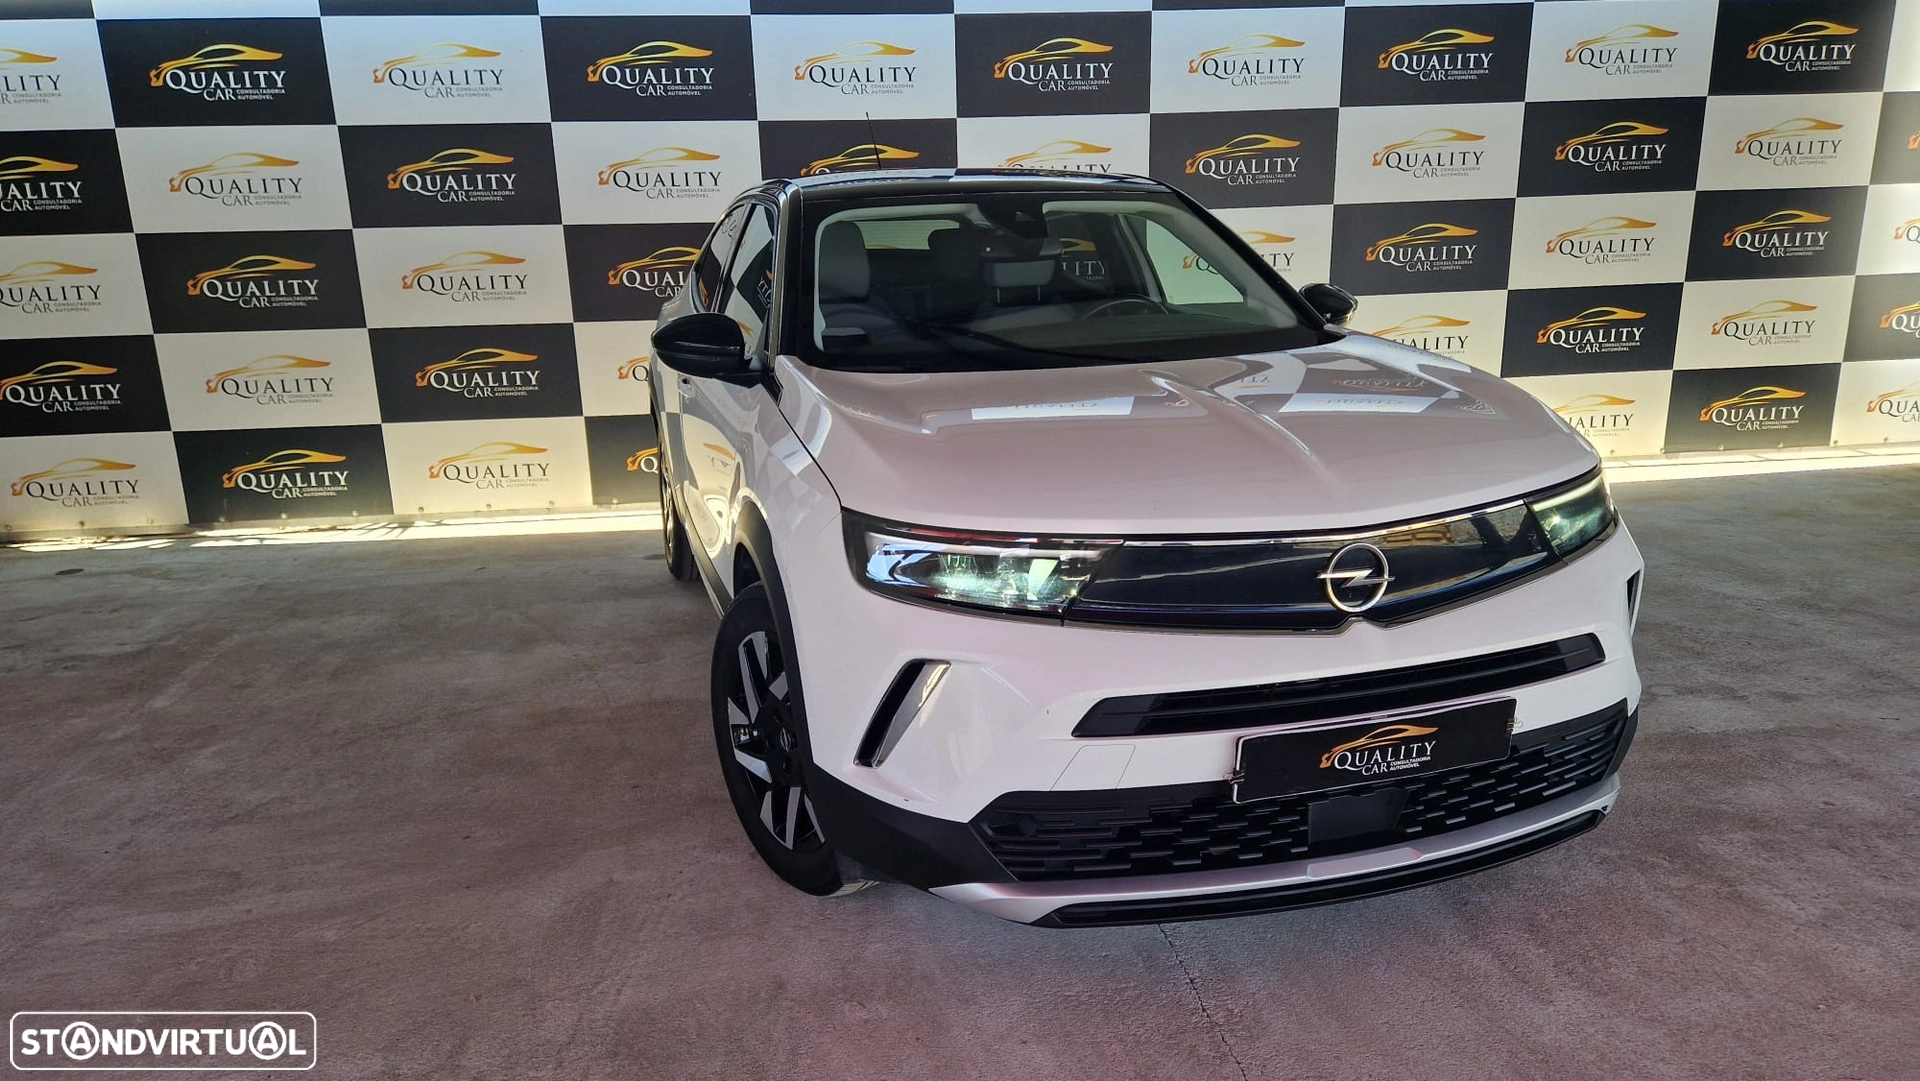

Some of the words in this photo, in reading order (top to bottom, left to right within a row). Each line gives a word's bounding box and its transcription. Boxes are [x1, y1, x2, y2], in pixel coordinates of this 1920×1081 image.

[1577, 47, 1678, 69] QUALITY
[1759, 43, 1856, 65] QUALITY
[1201, 57, 1305, 80] QUALITY
[1391, 52, 1493, 74] QUALITY
[1605, 64, 1631, 75] CAR
[1785, 60, 1810, 71] CAR
[387, 67, 504, 91] QUALITY
[601, 65, 714, 89] QUALITY
[808, 64, 917, 87] QUALITY
[1007, 61, 1113, 84] QUALITY
[1419, 70, 1446, 81] CAR
[0, 74, 62, 92] LITY
[165, 69, 286, 93] QUALITY
[1038, 80, 1066, 91] CAR
[1231, 75, 1258, 86] CAR
[203, 88, 236, 100] CAR
[424, 86, 455, 98] CAR
[636, 84, 666, 96] CAR
[840, 83, 869, 95] CAR
[1567, 143, 1667, 165] QUALITY
[1747, 139, 1843, 160] QUALITY
[1198, 156, 1300, 179] QUALITY
[1384, 150, 1485, 172] QUALITY
[1594, 161, 1620, 172] CAR
[1773, 155, 1797, 166] CAR
[1227, 174, 1254, 185] CAR
[1413, 167, 1439, 178] CAR
[184, 175, 303, 199] QUALITY
[402, 172, 516, 195] QUALITY
[612, 169, 722, 192] QUALITY
[221, 194, 254, 206] CAR
[437, 191, 468, 202] CAR
[645, 187, 675, 199] CAR
[0, 200, 33, 212] CAR
[1558, 237, 1655, 258] QUALITY
[1735, 231, 1829, 251] QUALITY
[1378, 244, 1477, 266] QUALITY
[1584, 254, 1610, 264] CAR
[1760, 247, 1784, 257] CAR
[1406, 261, 1431, 272] CAR
[202, 278, 319, 301] QUALITY
[416, 273, 528, 295] QUALITY
[239, 296, 271, 308] CAR
[451, 291, 481, 302] CAR
[21, 302, 54, 314] CAR
[1723, 319, 1816, 340] QUALITY
[1549, 327, 1645, 348] QUALITY
[1748, 335, 1772, 346] CAR
[1575, 343, 1600, 353] CAR
[429, 370, 540, 391] QUALITY
[5, 383, 121, 406] QUALITY
[220, 377, 334, 399] QUALITY
[464, 387, 493, 398] CAR
[42, 401, 73, 412] CAR
[256, 394, 287, 405] CAR
[1711, 405, 1804, 425] QUALITY
[1736, 421, 1760, 431] CAR
[442, 462, 550, 483] QUALITY
[237, 470, 348, 492] QUALITY
[476, 479, 505, 489] CAR
[25, 479, 139, 501] QUALITY
[272, 487, 302, 498] CAR
[61, 496, 93, 507] CAR
[1333, 740, 1437, 771] QUALITY
[1362, 762, 1389, 776] CAR
